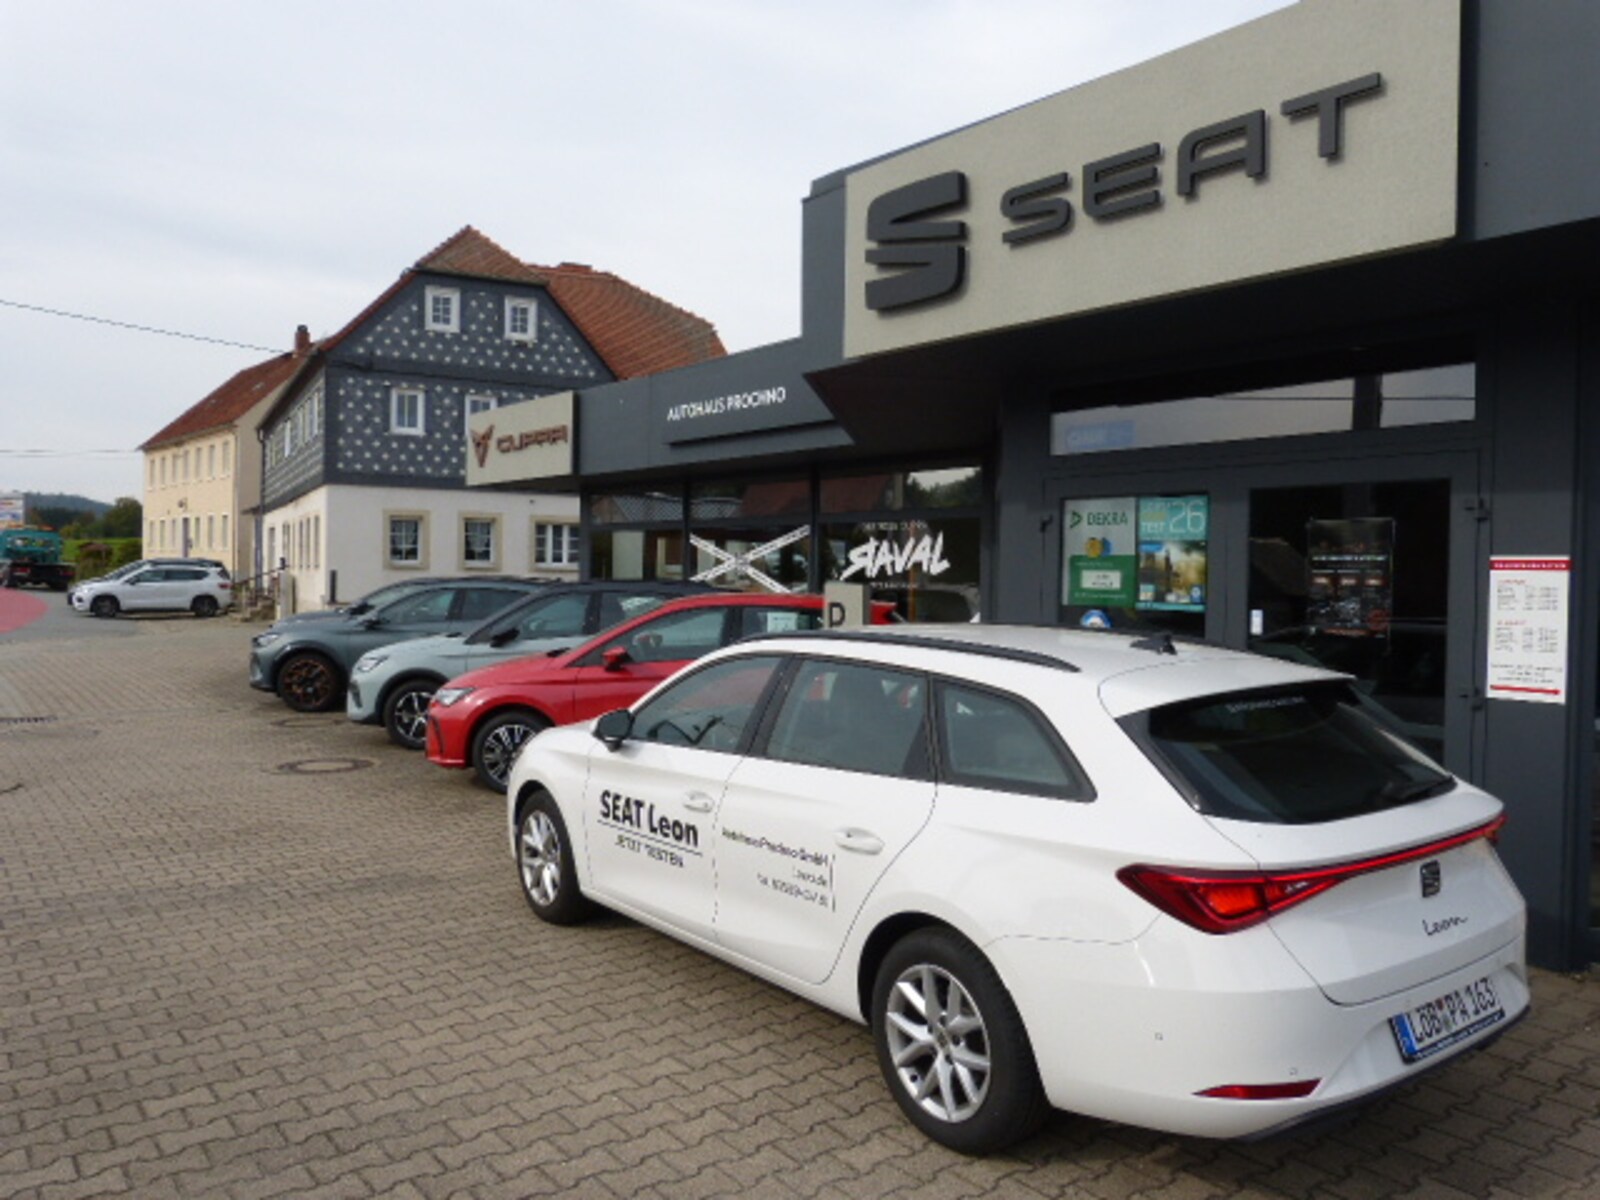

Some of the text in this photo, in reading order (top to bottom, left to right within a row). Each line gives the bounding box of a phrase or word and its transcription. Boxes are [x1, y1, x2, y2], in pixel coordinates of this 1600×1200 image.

[1000, 72, 1385, 246] SEAT
[666, 396, 725, 422] AUTOHAUS
[496, 424, 568, 453] CUPRA
[1087, 511, 1129, 526] DEKRA
[600, 789, 699, 848] SEAT Leon
[1422, 915, 1469, 936] Leon
